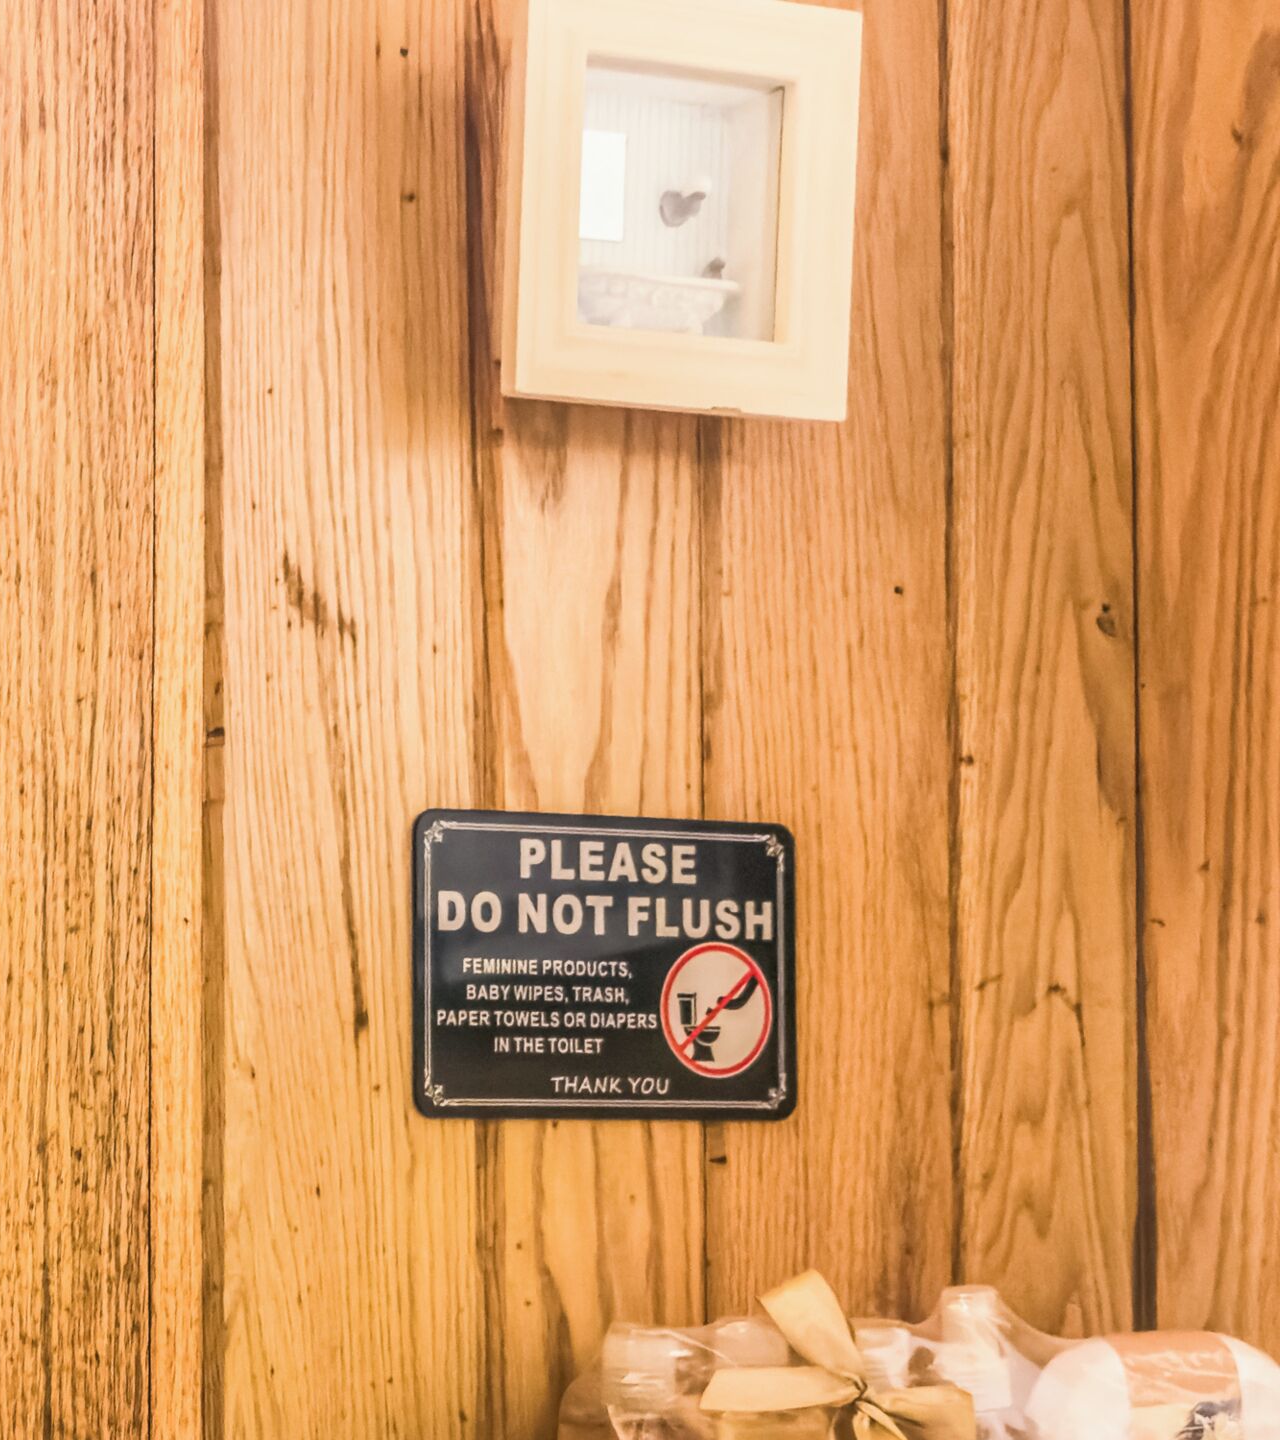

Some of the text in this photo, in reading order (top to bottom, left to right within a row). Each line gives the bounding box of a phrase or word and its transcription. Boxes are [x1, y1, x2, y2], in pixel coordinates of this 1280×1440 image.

[519, 838, 697, 885] PLEASE
[437, 890, 773, 941] DO NOT FLUSH
[462, 957, 633, 979] FEMININE PRODUCTS,
[466, 984, 630, 1006] BABY WIPES, TRASH,
[436, 1009, 658, 1030] PAPER TOWELS OR DIAPERS
[493, 1036, 604, 1054] IN THE TOILET
[550, 1076, 670, 1095] THANK YOU
